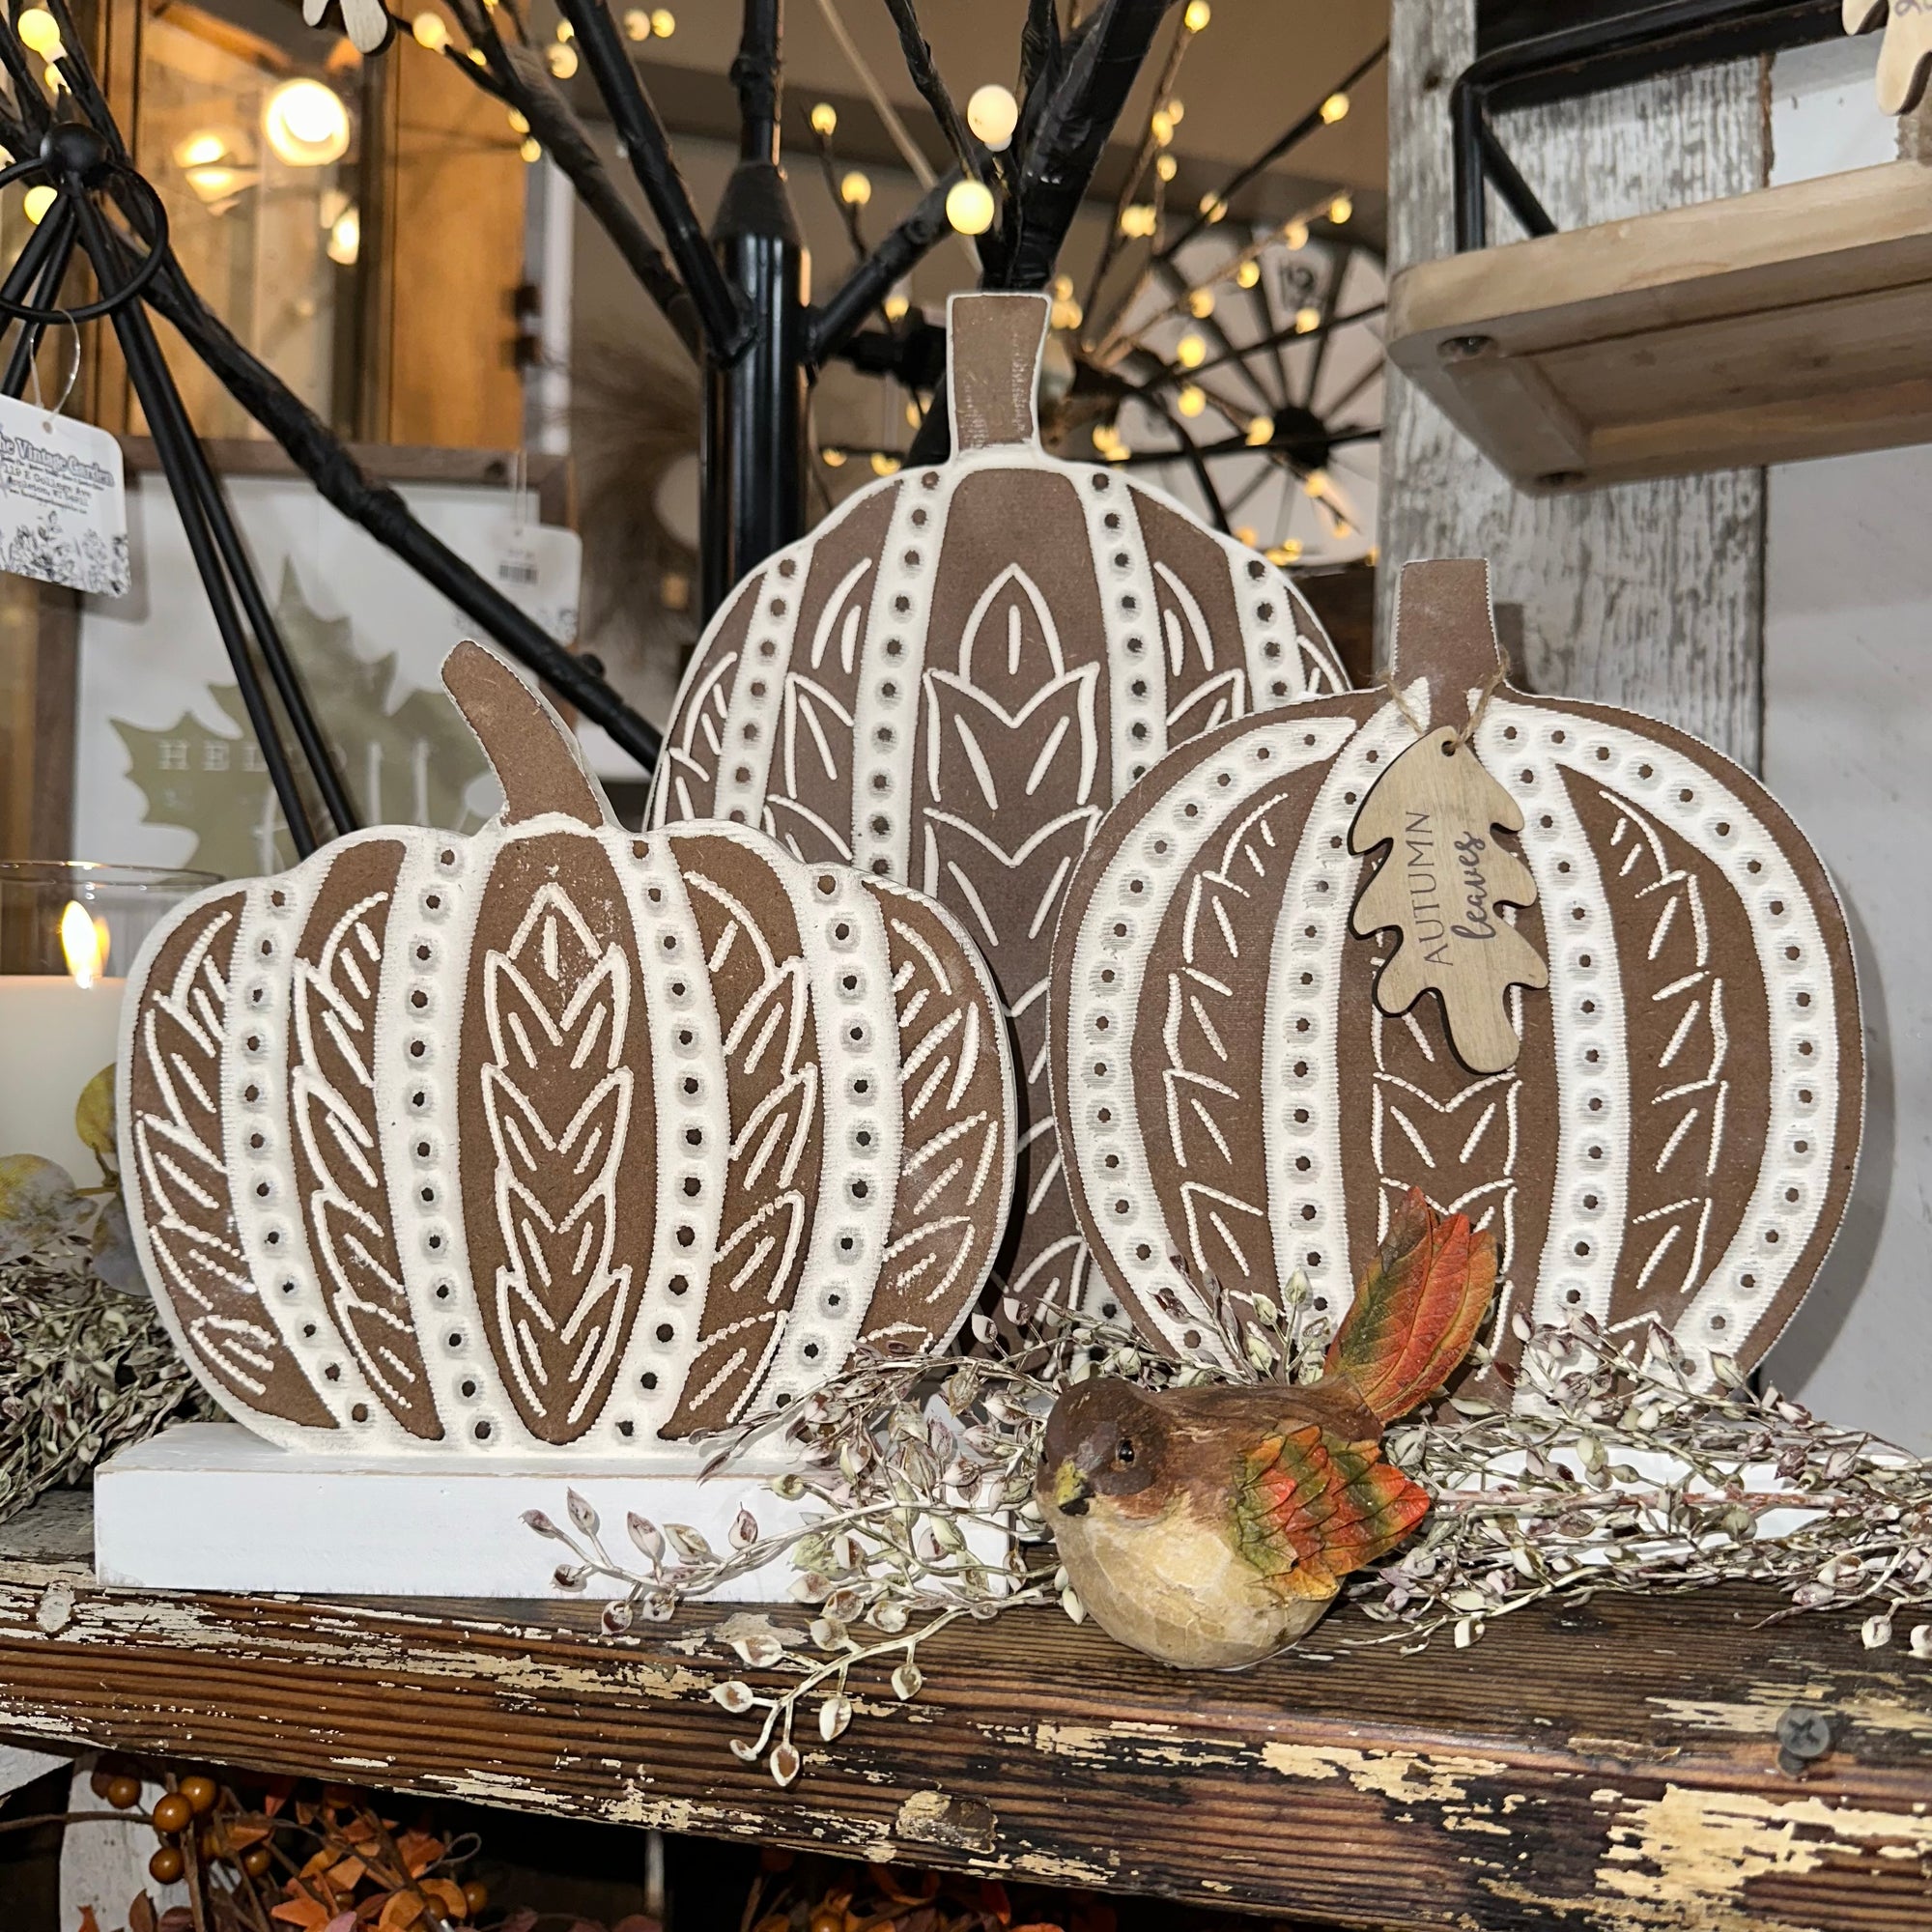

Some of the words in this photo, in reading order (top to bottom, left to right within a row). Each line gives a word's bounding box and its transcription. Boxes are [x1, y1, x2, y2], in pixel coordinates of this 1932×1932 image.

[0, 431, 14, 455] he
[14, 437, 69, 472] Vintage
[68, 455, 115, 487] Garden
[1406, 810, 1454, 967] AUTUMN
[1451, 830, 1496, 940] leaves
